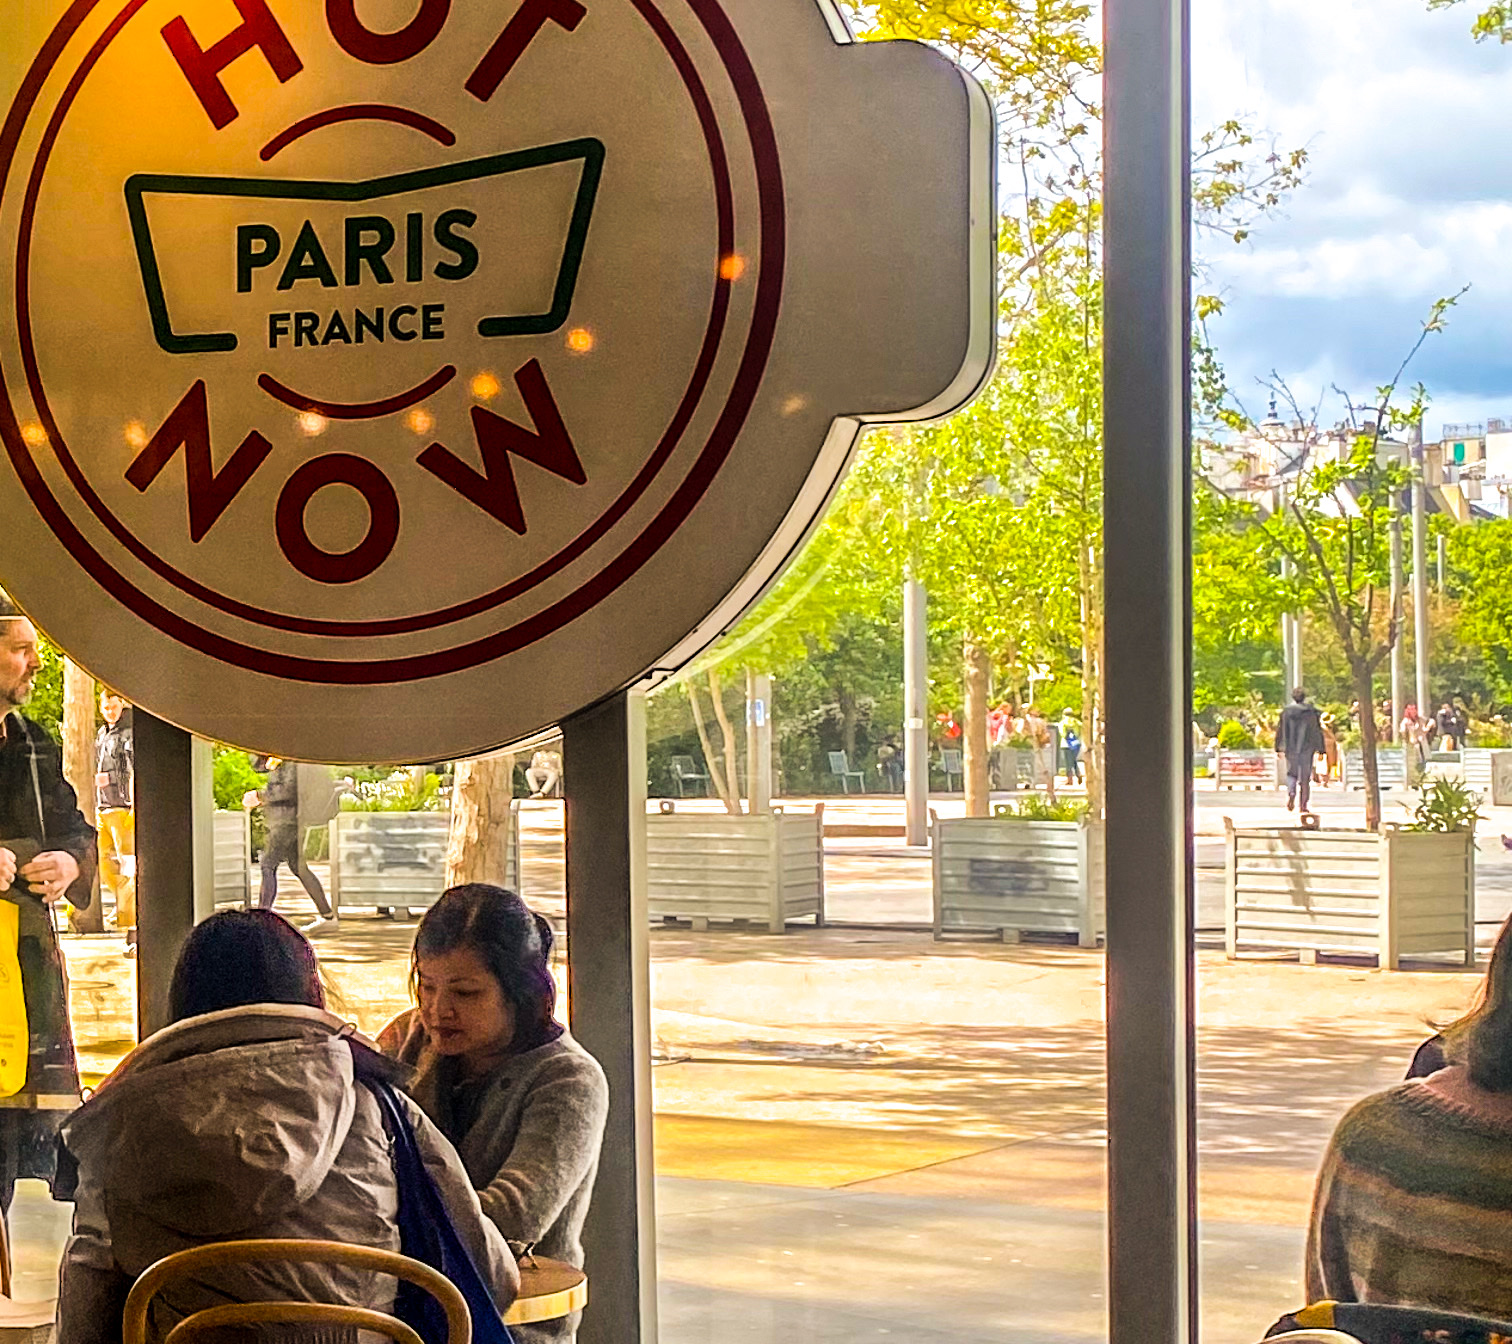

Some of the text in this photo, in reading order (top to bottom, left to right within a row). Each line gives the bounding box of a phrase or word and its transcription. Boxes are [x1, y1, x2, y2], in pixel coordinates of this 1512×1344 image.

[236, 208, 480, 294] PARIS
[268, 303, 445, 349] FRANCE
[125, 358, 588, 585] NOW
